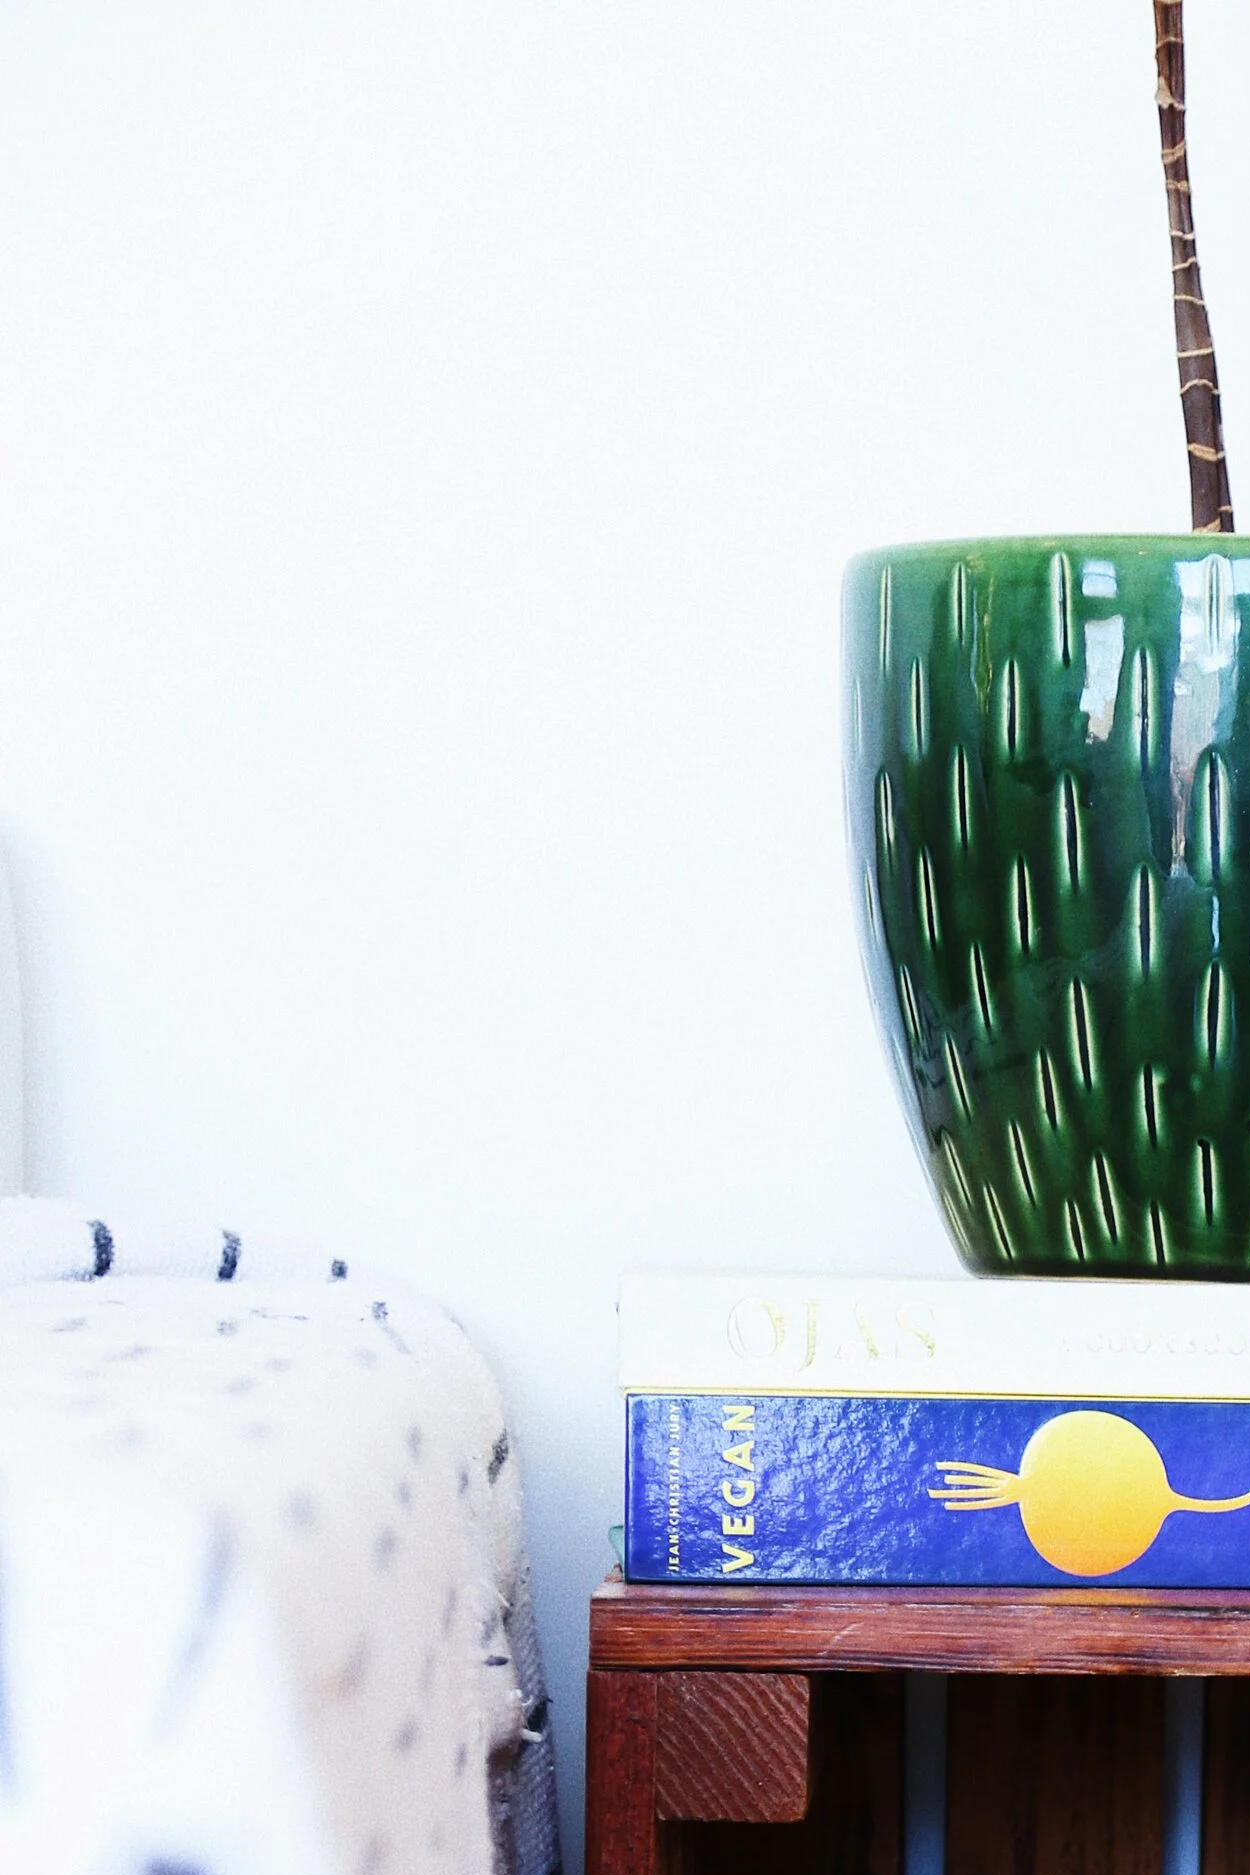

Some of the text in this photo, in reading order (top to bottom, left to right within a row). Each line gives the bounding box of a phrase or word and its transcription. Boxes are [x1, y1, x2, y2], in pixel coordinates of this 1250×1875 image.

[727, 1297, 937, 1370] OJAS
[668, 1404, 680, 1440] JURY
[722, 1405, 755, 1573] VEGAN
